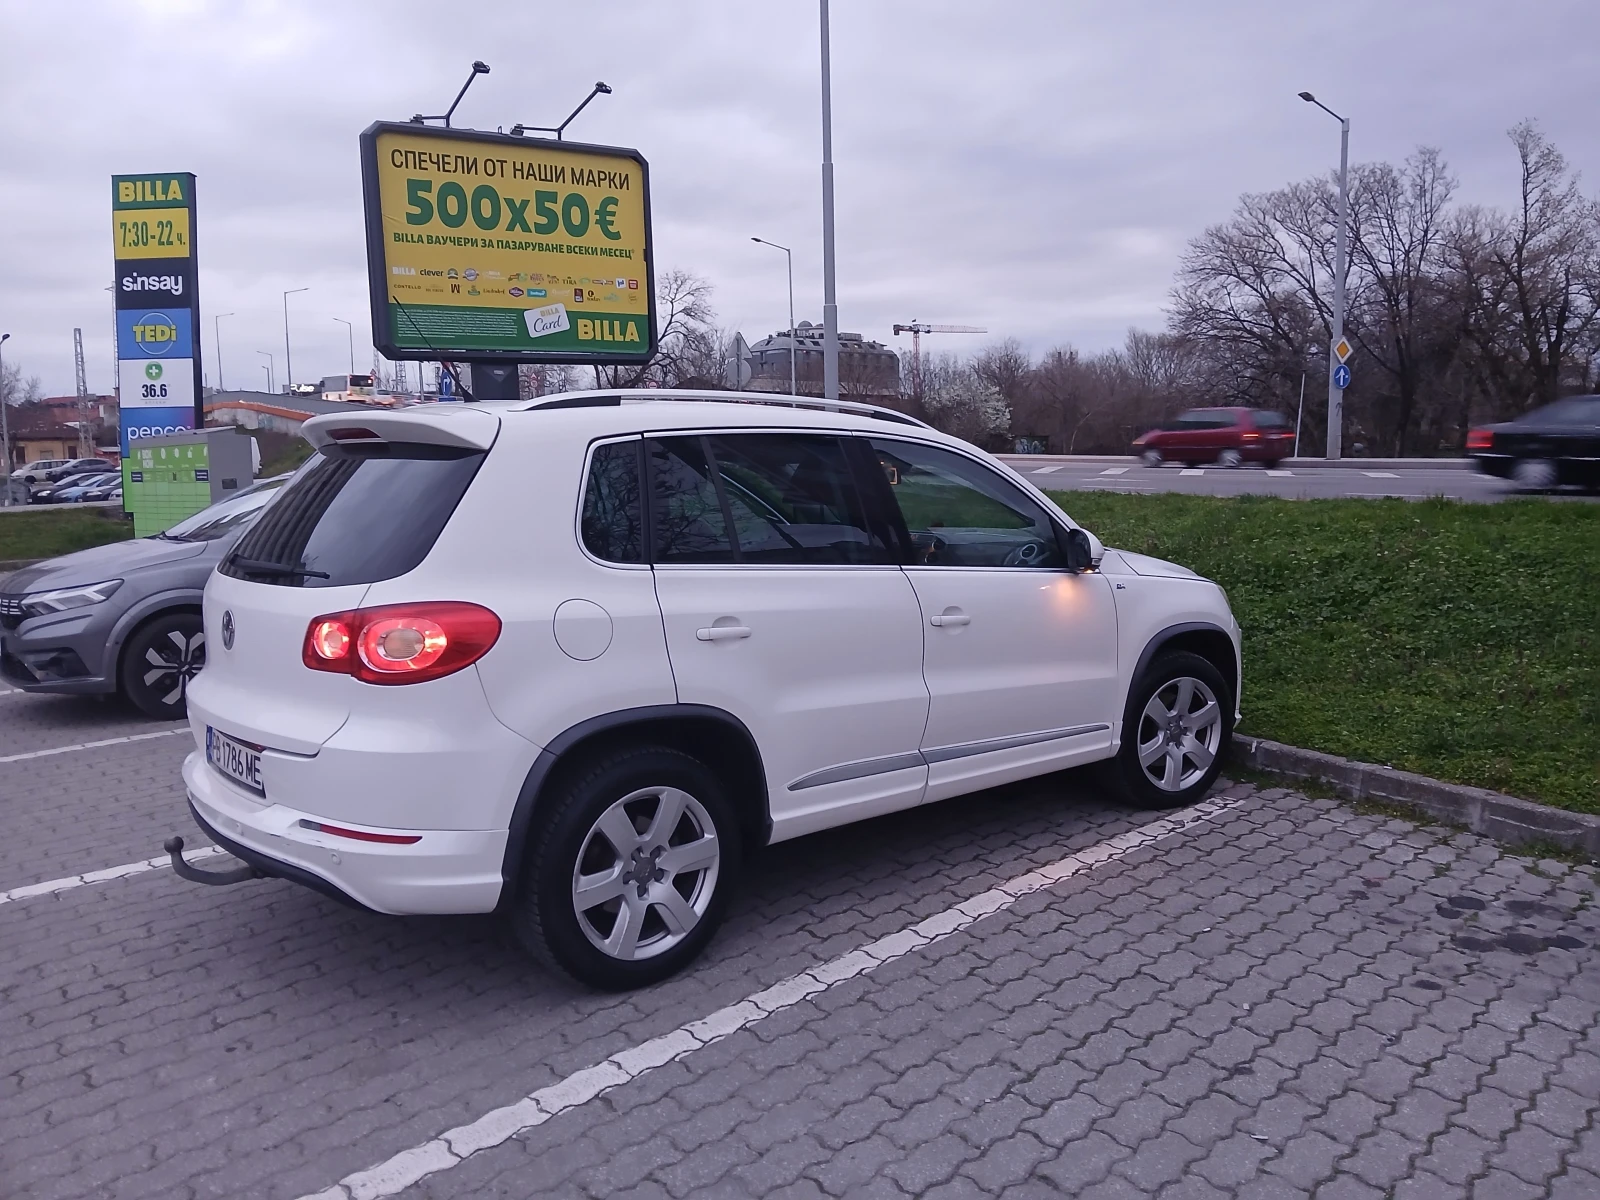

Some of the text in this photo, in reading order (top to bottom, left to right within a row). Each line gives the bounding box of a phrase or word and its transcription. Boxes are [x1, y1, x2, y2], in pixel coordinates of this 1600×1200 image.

[391, 148, 630, 191] СПЕЧЕЛИ ОТ НАШИ МАРКИ
[118, 179, 184, 203] BILLA
[176, 232, 186, 246] ч.
[393, 232, 425, 245] BILLA
[426, 234, 479, 249] ВАУЧЕРИ
[480, 238, 495, 249] ЗА
[496, 239, 565, 255] ПАЗАРУВАНЕ
[566, 244, 598, 256] ВСЕКИ
[392, 266, 417, 276] BILLA
[419, 268, 445, 277] clever
[122, 272, 184, 296] sinsay
[540, 307, 561, 317] BILLA
[132, 324, 178, 344] TEDi
[533, 314, 562, 334] Card
[577, 318, 640, 342] BILLA
[141, 383, 168, 399] 36.6
[222, 740, 243, 777] 1786
[245, 751, 261, 786] ME
